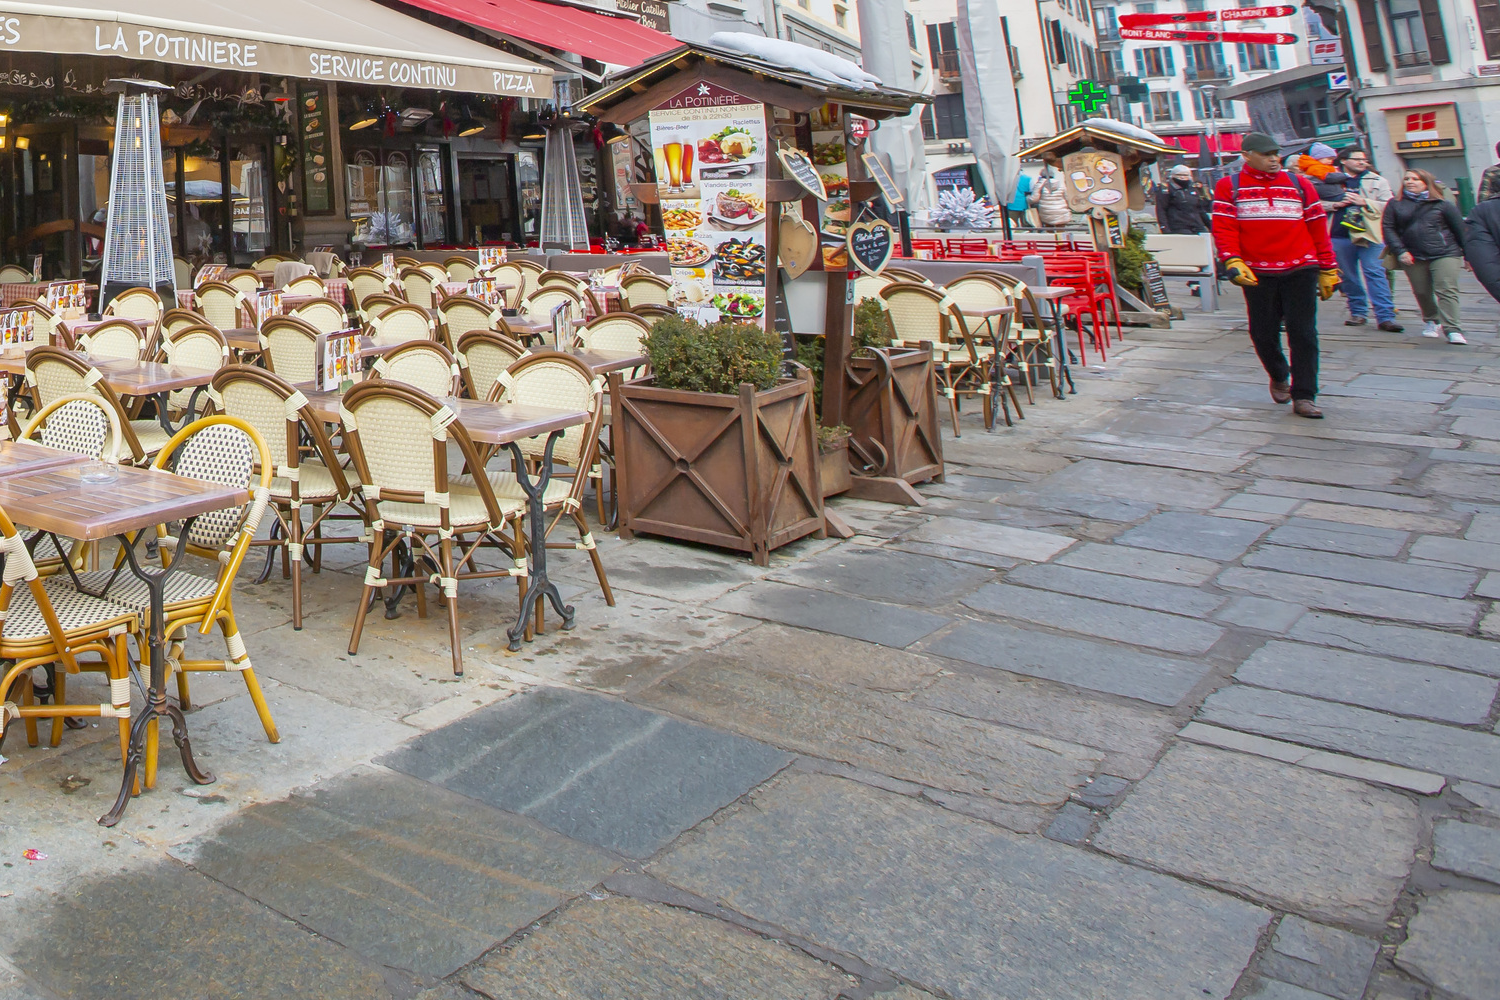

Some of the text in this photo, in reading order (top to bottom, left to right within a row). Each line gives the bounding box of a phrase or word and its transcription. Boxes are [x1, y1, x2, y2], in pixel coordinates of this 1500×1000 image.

[1222, 8, 1268, 19] CHAMONIX
[1121, 28, 1172, 39] MONT-BLANC
[95, 24, 259, 67] LA POTINIERE
[310, 52, 457, 87] SERVICE CONTINU
[493, 72, 536, 93] PIZZA
[670, 99, 683, 108] LA
[683, 107, 717, 115] CONTINU
[709, 112, 732, 120] 22h30
